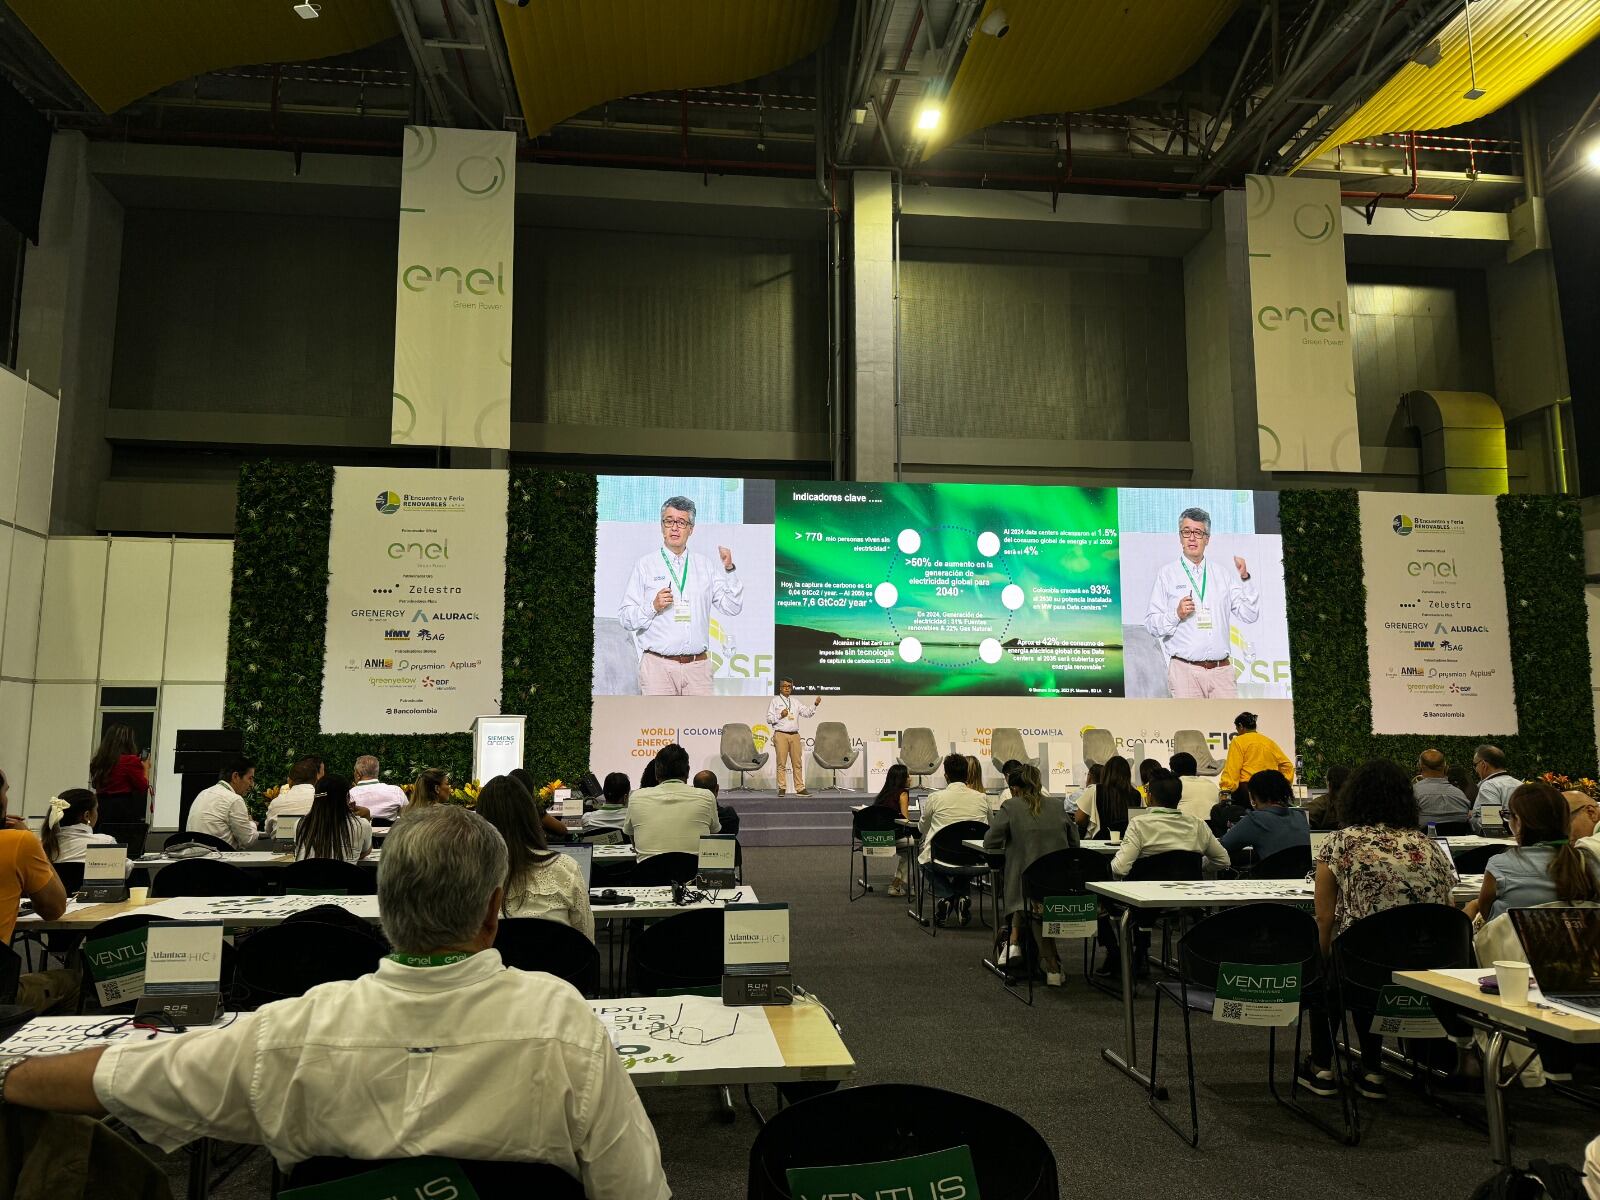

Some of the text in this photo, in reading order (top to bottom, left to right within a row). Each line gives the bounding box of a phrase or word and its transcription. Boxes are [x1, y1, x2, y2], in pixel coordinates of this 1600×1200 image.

[403, 262, 505, 295] enel
[454, 301, 503, 310] Green Power
[1257, 301, 1344, 332] enel
[793, 492, 866, 502] Indicadores clave
[806, 532, 822, 541] 770
[388, 538, 448, 559] enel
[1023, 546, 1038, 555] 4%
[1408, 558, 1458, 577] enel
[409, 585, 462, 594] Zelestra
[936, 587, 958, 596] 2040
[1090, 585, 1110, 594] 93%
[1429, 600, 1471, 609] Zelestra
[364, 659, 384, 668] ANH
[1046, 903, 1094, 912] VENTUS
[89, 941, 148, 966] VENTU
[408, 956, 431, 965] enel
[1223, 974, 1296, 988] VENTUS
